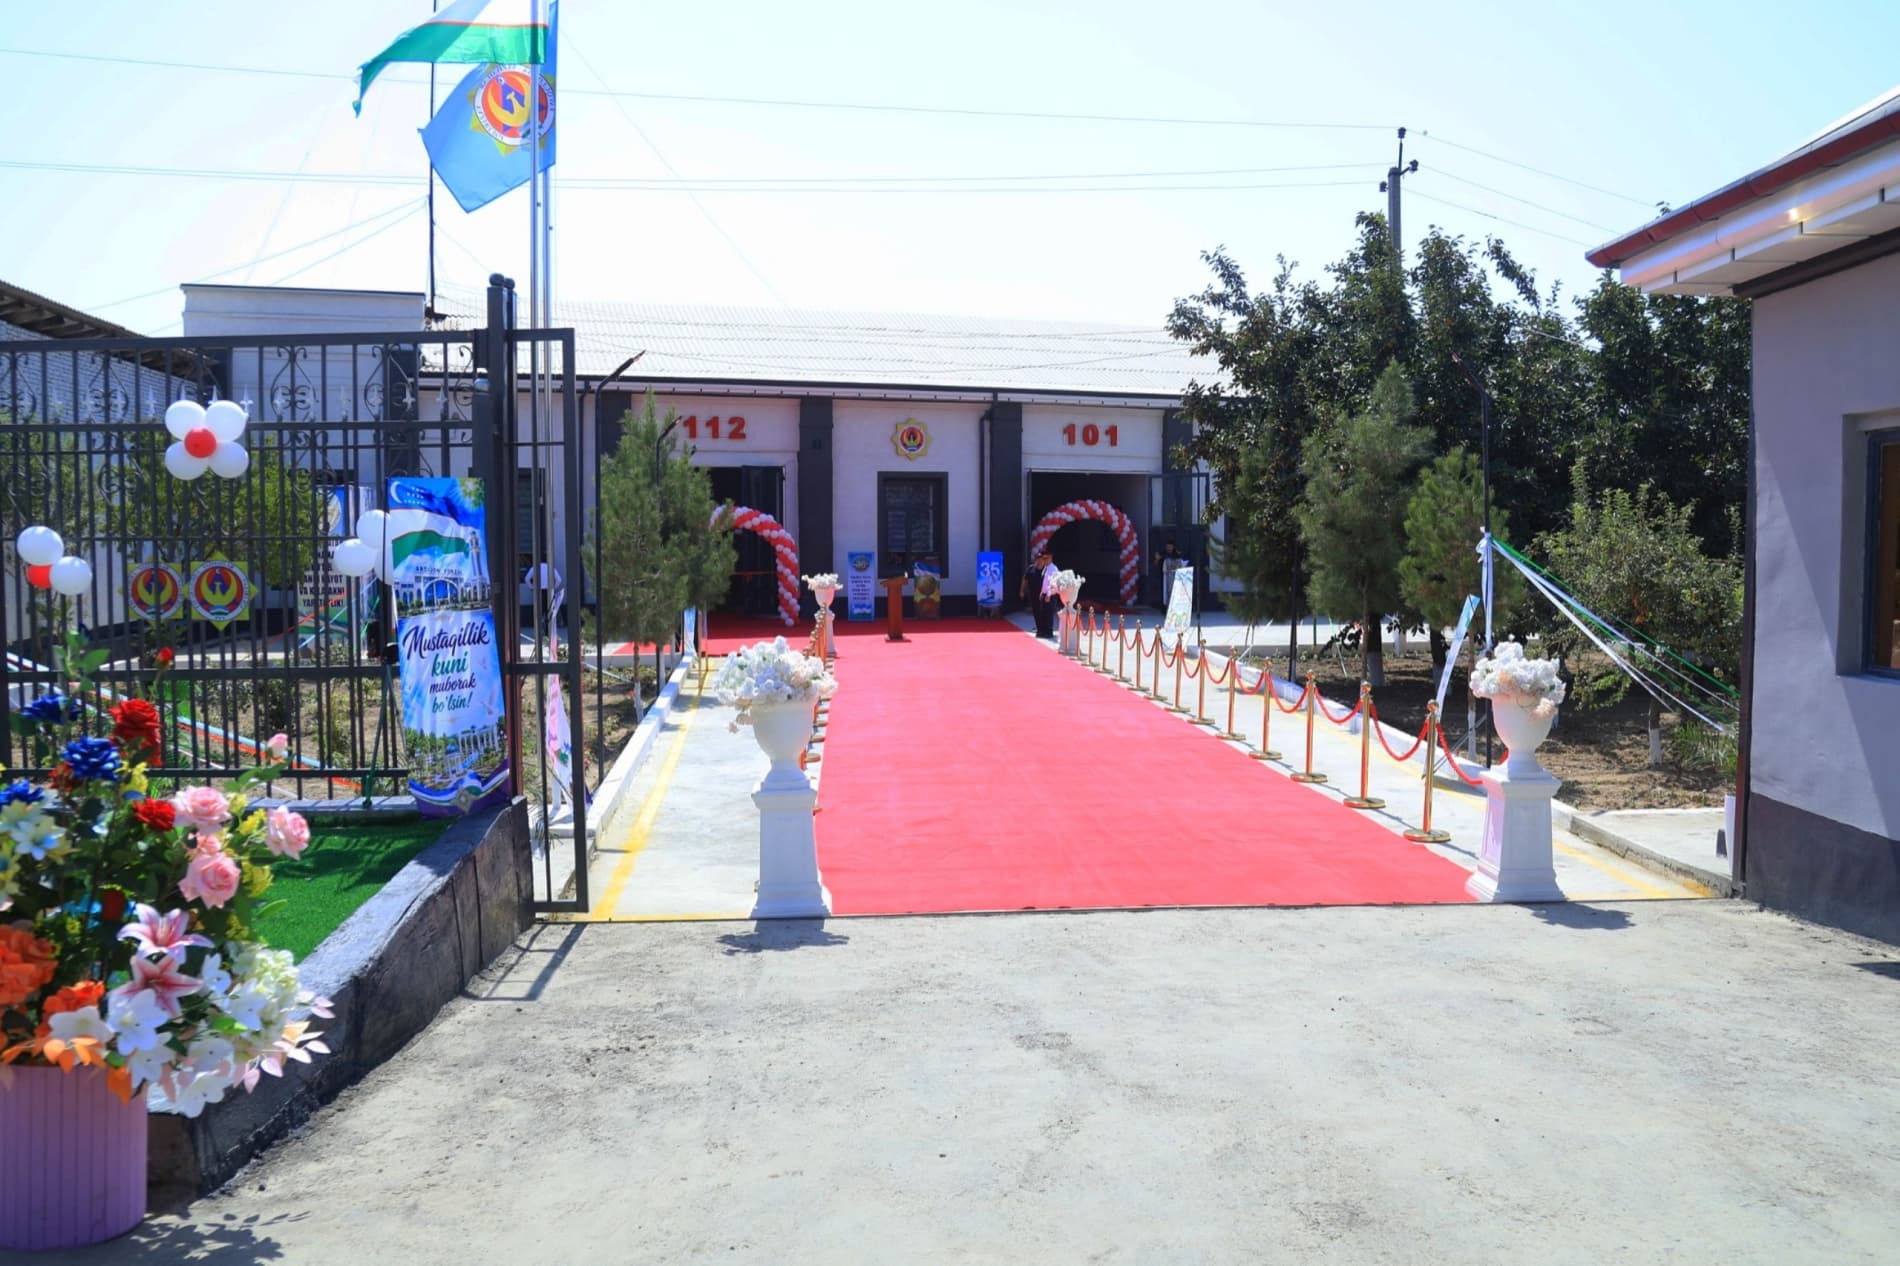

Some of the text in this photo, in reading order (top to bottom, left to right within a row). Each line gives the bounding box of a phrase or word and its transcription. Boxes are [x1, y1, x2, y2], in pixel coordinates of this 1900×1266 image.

[682, 415, 747, 440] 112
[1063, 423, 1118, 447] 101
[980, 561, 1001, 577] 35
[402, 621, 490, 661] Mustaqillik
[431, 651, 469, 677] kuni
[429, 672, 477, 694] muborak
